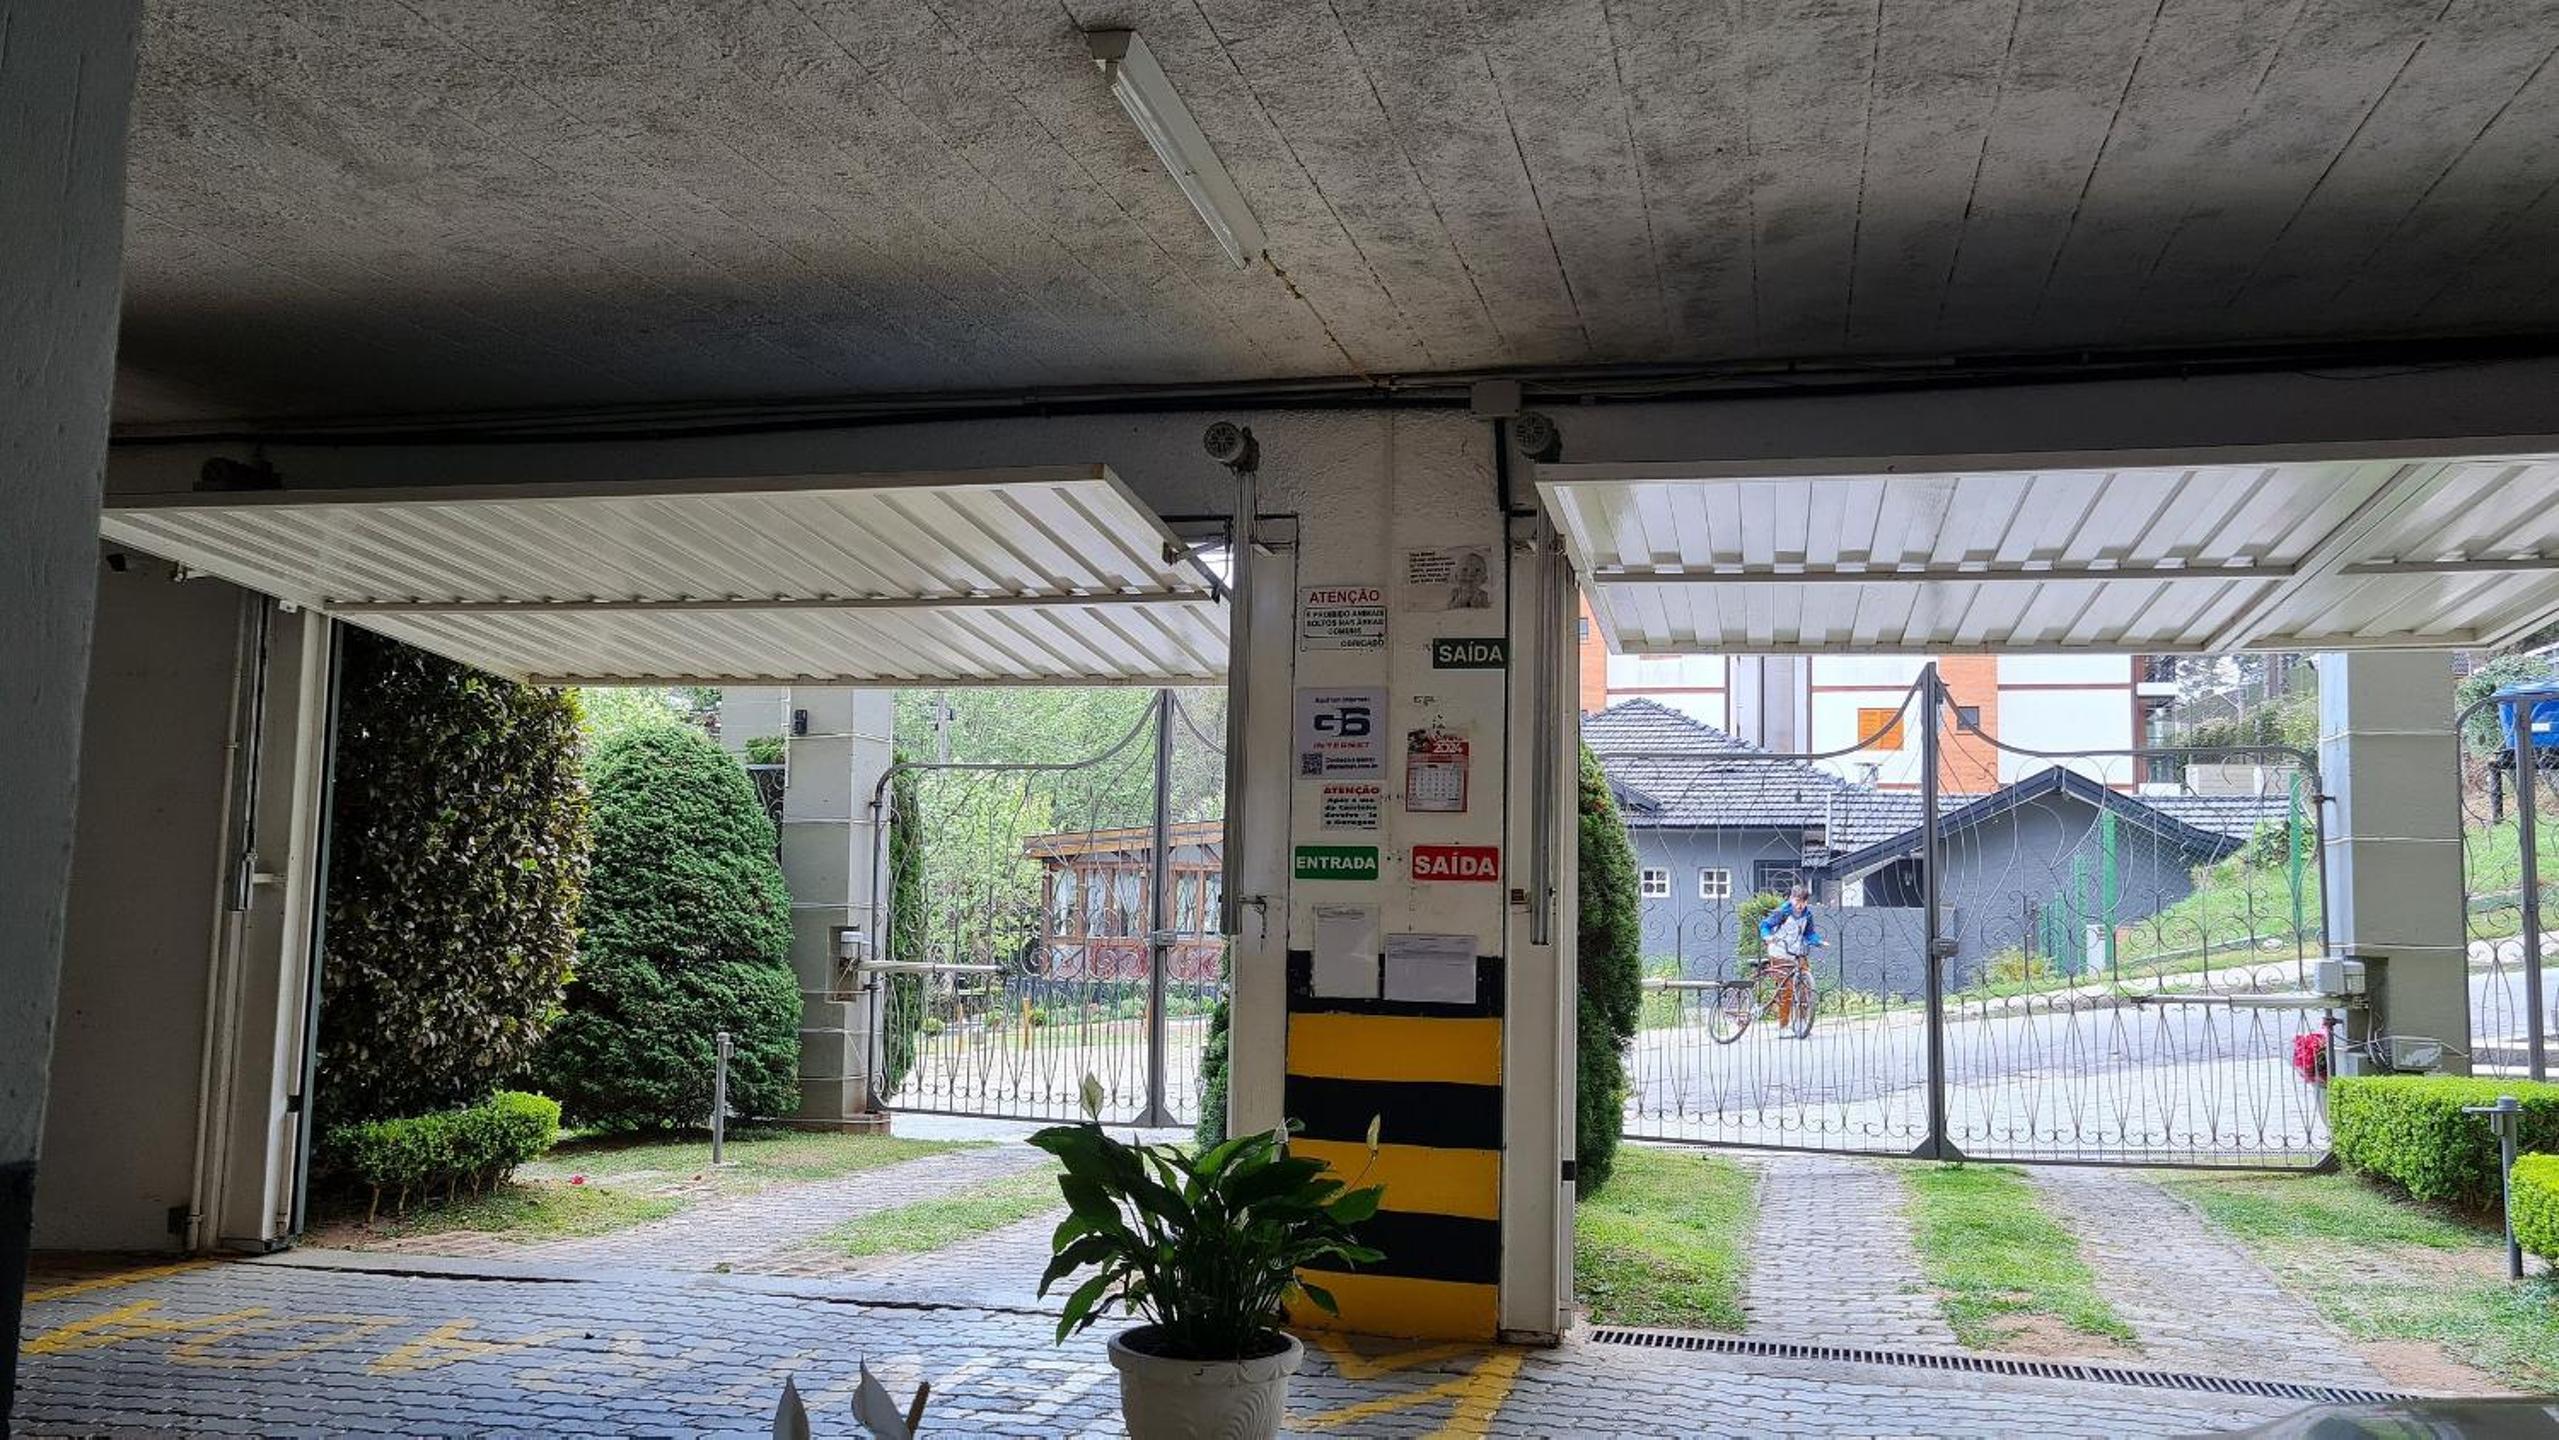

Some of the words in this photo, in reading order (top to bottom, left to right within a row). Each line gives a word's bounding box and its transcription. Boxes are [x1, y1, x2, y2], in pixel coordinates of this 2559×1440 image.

[1310, 588, 1380, 604] ATENÇÃO
[1439, 641, 1503, 662] SAÍDA
[1313, 741, 1370, 750] INTERNET
[1324, 785, 1380, 796] ATENÇÃO
[1296, 856, 1376, 870] ENTRADA
[1414, 852, 1496, 876] SAÍDA
